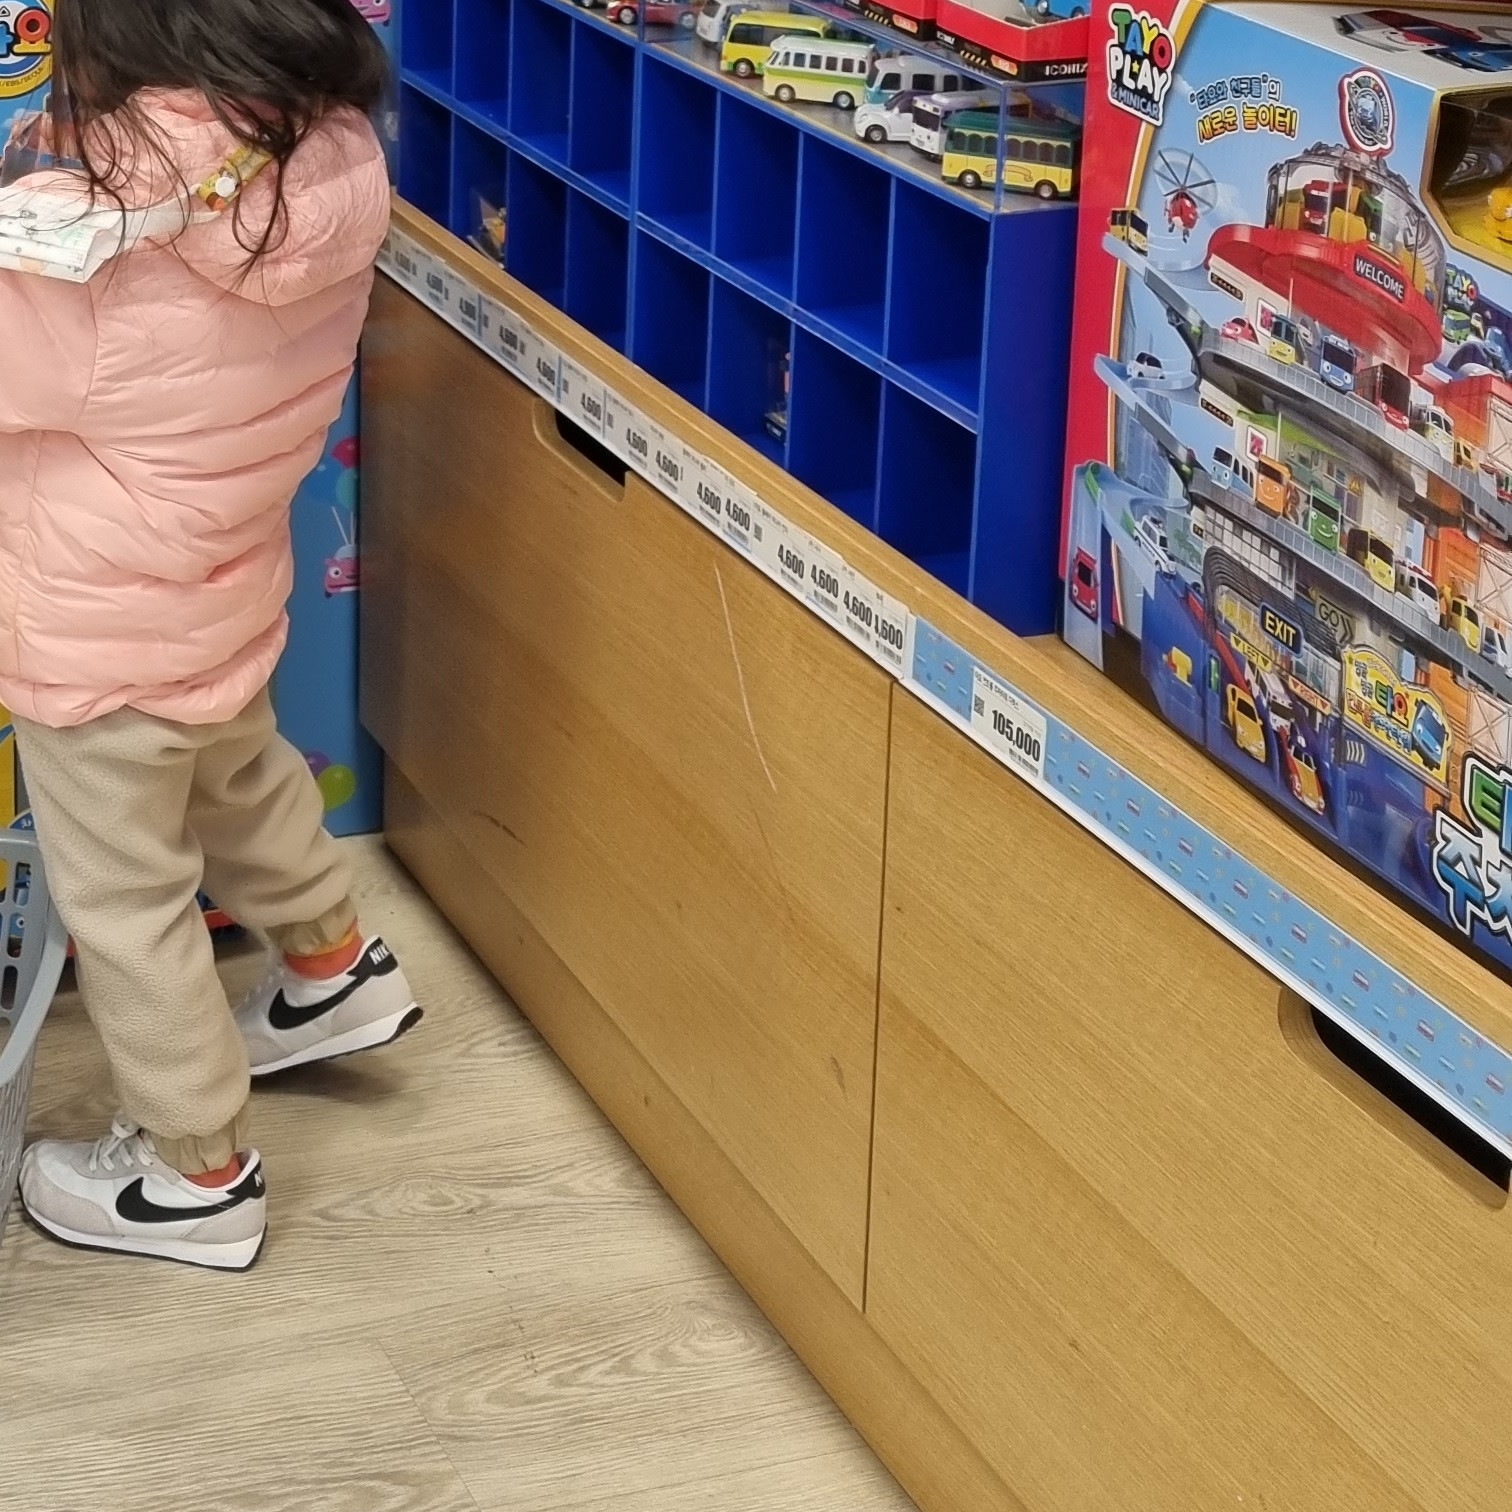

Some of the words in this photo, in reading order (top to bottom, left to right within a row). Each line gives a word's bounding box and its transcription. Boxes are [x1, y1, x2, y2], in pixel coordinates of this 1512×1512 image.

[1111, 8, 1173, 70] TAYO
[1108, 44, 1168, 95] PLAY
[1197, 109, 1239, 141] 새로운
[1241, 103, 1298, 138] 놀이터!
[1355, 257, 1405, 300] WELCOME
[626, 428, 649, 458] 4,600
[655, 450, 679, 482] 4,600
[696, 481, 722, 515] 4,600
[725, 497, 751, 532] 4,600
[777, 543, 805, 580] 4,600
[810, 564, 839, 599] 4,600
[843, 590, 873, 628] 4,600
[1319, 601, 1340, 629] GO
[1265, 612, 1297, 649] EXIT
[991, 709, 1041, 763] 105,000
